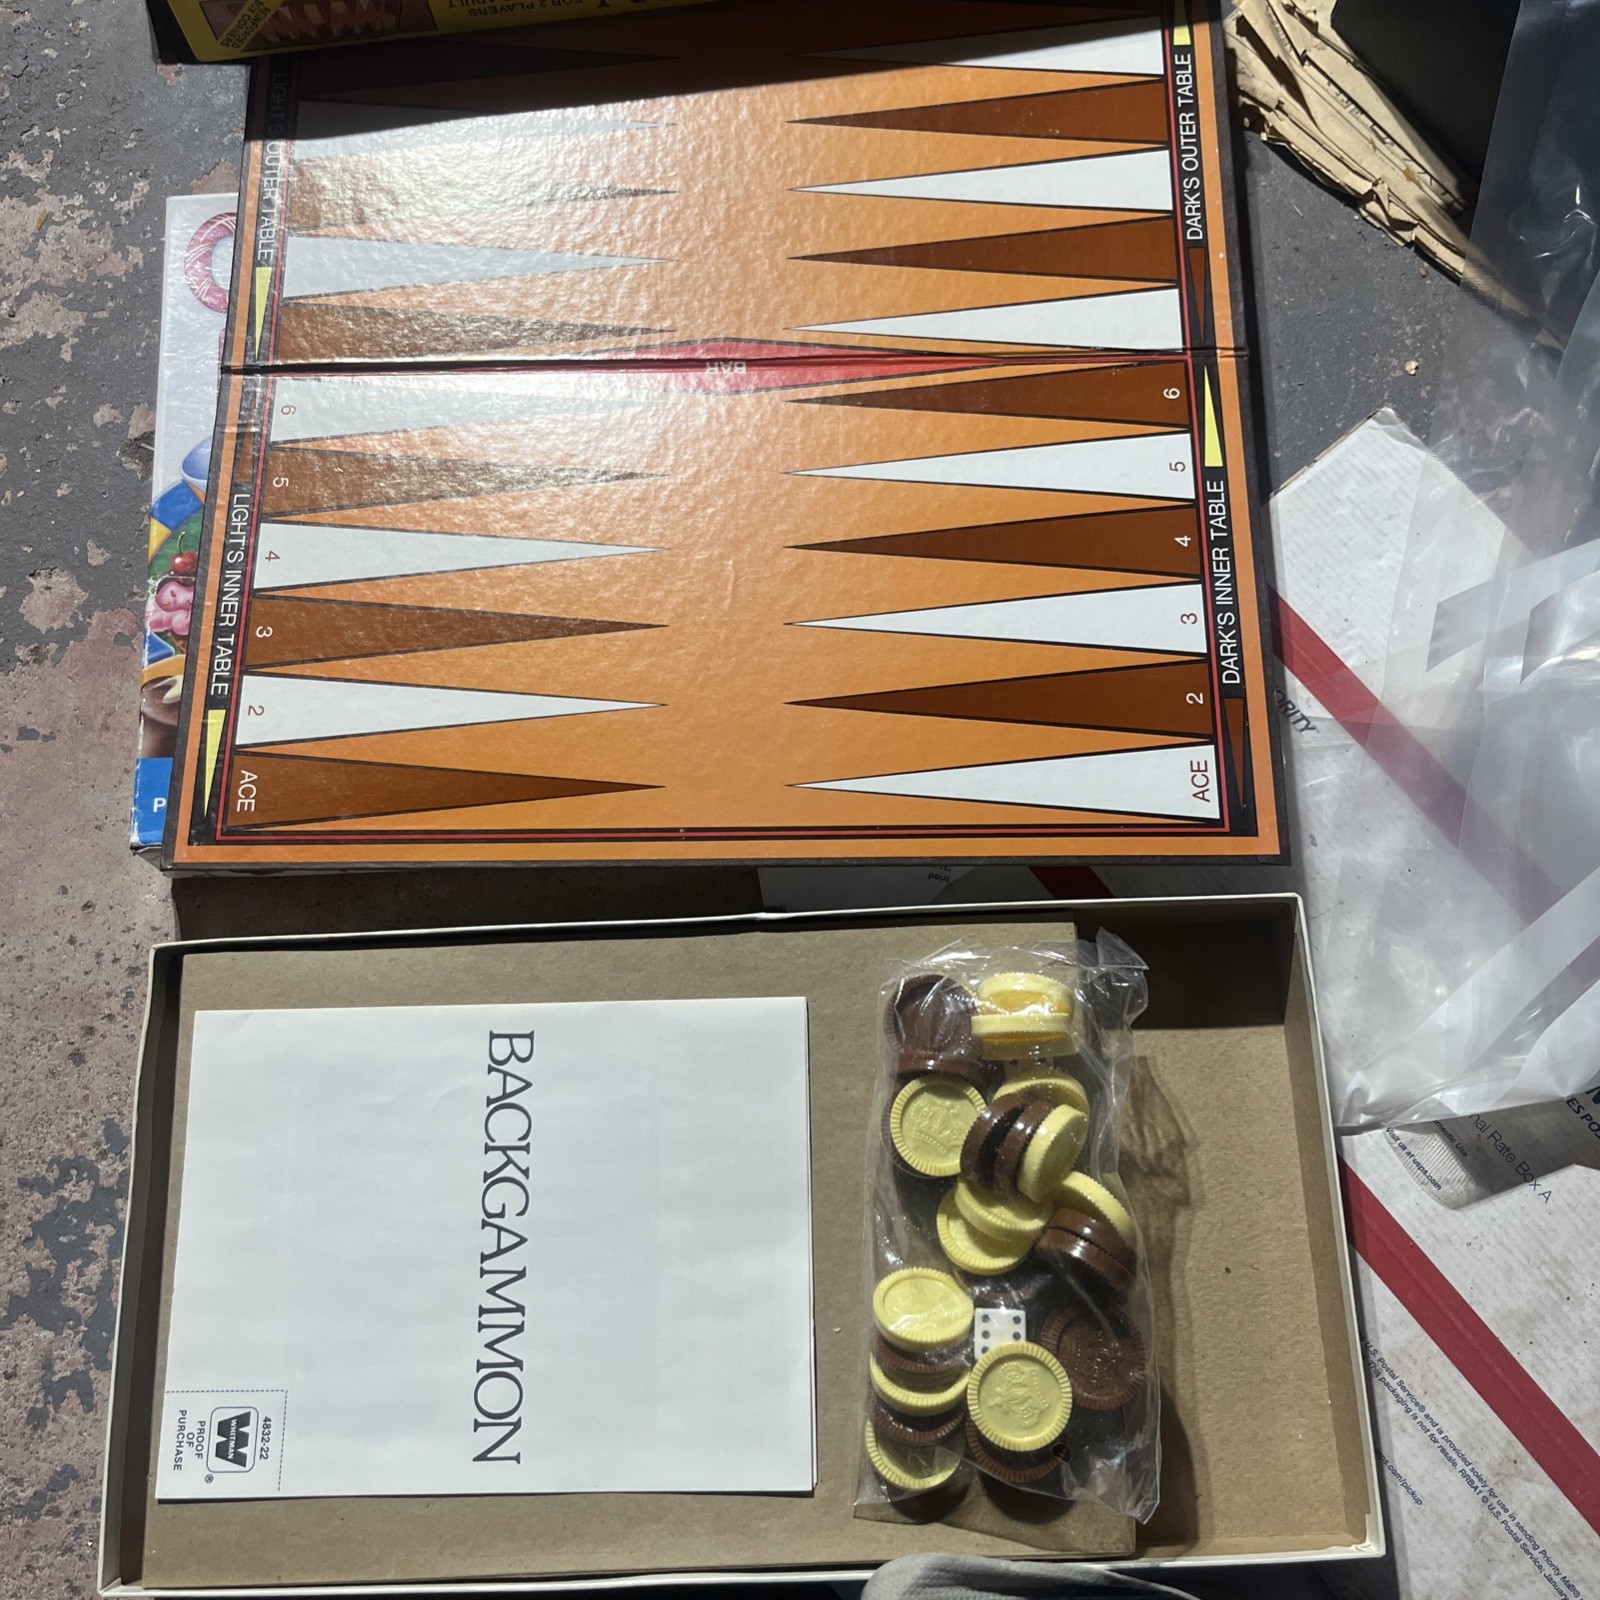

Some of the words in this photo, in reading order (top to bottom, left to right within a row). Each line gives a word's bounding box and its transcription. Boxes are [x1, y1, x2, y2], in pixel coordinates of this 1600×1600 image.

[467, 1, 536, 16] PLAYERS
[1174, 54, 1194, 107] TABLE
[267, 73, 289, 138] LIGHTS
[1179, 112, 1199, 171] OUTER
[263, 141, 282, 200] OUTER
[1183, 177, 1203, 240] DARK'S
[257, 208, 278, 261] TABLE
[705, 361, 747, 375] BAR
[280, 404, 297, 416] 6
[1163, 387, 1181, 400] 6
[272, 477, 289, 489] 5
[1169, 460, 1186, 473] 5
[226, 493, 251, 564] LIGHT'S
[1206, 480, 1228, 540] TABLE
[265, 550, 281, 562] 4
[1174, 534, 1192, 547] 4
[218, 570, 242, 627] INNER
[1212, 547, 1234, 605] INNER
[255, 626, 273, 638] 3
[1180, 612, 1198, 625] 3
[210, 633, 235, 696] TABLE
[1217, 612, 1240, 684] DARK'S
[247, 705, 265, 717] 2
[1185, 692, 1204, 705] 2
[236, 769, 258, 812] ACE
[1189, 759, 1211, 803] ACE
[1386, 1127, 1400, 1142] Visit
[1397, 1142, 1407, 1151] us
[1405, 1151, 1415, 1159] at
[1412, 1159, 1441, 1191] usps.com
[1455, 1142, 1468, 1157] Use
[1486, 1130, 1516, 1163] Rate
[1514, 1160, 1542, 1191] Box
[1537, 1190, 1552, 1203] A
[472, 1029, 535, 1466] BACKGAMMON
[173, 1409, 187, 1471] PURCHASE
[186, 1431, 195, 1448] OF
[194, 1420, 206, 1460] PROOF
[227, 1418, 238, 1460] WHITMAN
[259, 1415, 272, 1460] 4832-22
[1364, 1341, 1379, 1358] U.S.
[1377, 1357, 1400, 1381] Postal
[1423, 1412, 1439, 1428] and
[1435, 1427, 1445, 1436] is
[1440, 1435, 1472, 1467] provided
[1469, 1466, 1489, 1489] solely
[1486, 1487, 1499, 1499] for
[1496, 1499, 1510, 1514] use
[1507, 1512, 1517, 1522] in
[1514, 1521, 1540, 1551] sending
[1538, 1549, 1562, 1576] Priority
[1367, 1360, 1382, 1379] This
[1378, 1376, 1413, 1414] packaging
[1410, 1412, 1419, 1421] is
[1416, 1419, 1431, 1435] not
[1428, 1433, 1440, 1444] for
[1437, 1444, 1458, 1469] resale.
[1458, 1468, 1483, 1496] RRBA1
[1487, 1503, 1502, 1521] U.S.
[1500, 1519, 1523, 1543] Postal
